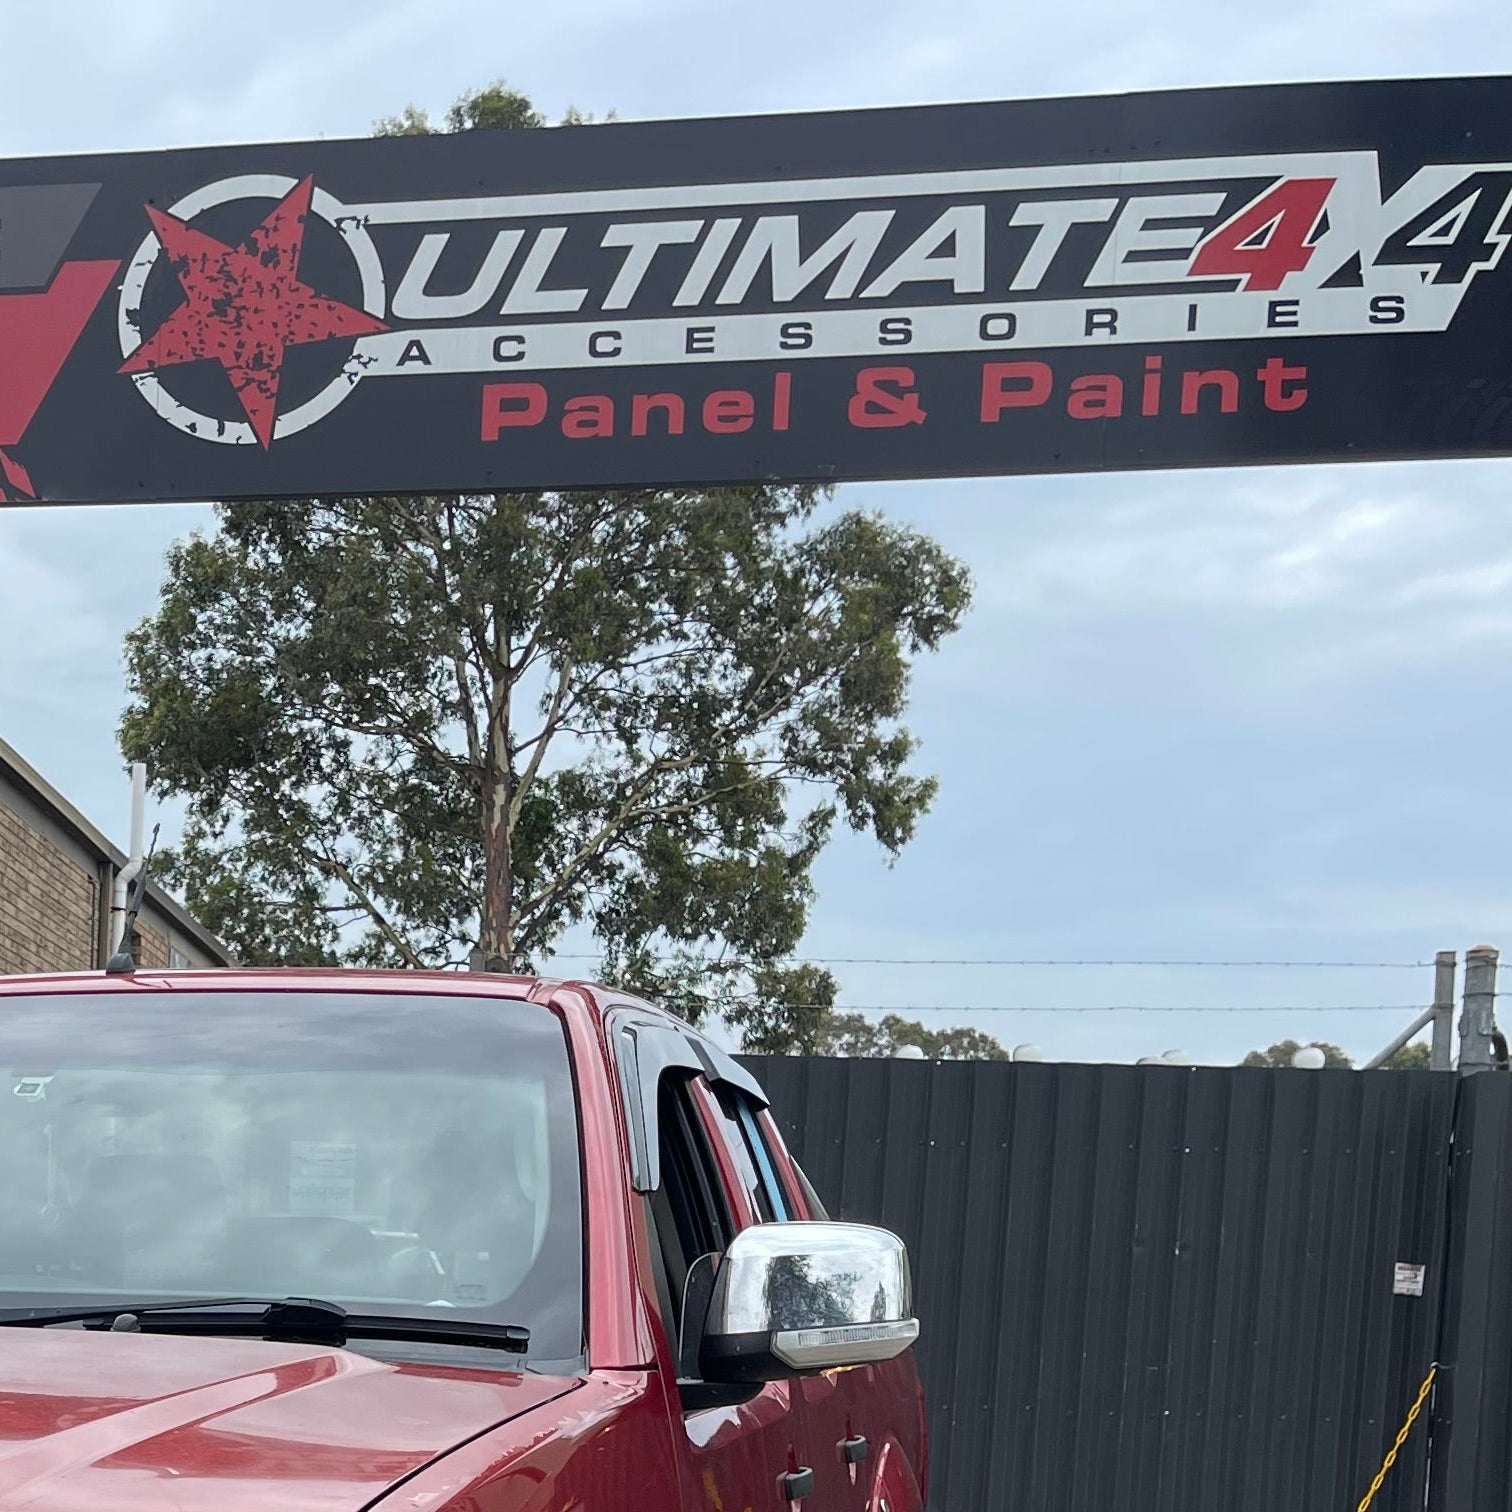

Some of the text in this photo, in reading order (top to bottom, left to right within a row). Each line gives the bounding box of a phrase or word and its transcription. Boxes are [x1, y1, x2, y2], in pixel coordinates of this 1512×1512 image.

[396, 294, 1406, 367] ACCESSORIES
[480, 355, 1308, 441] Panel & Paint
